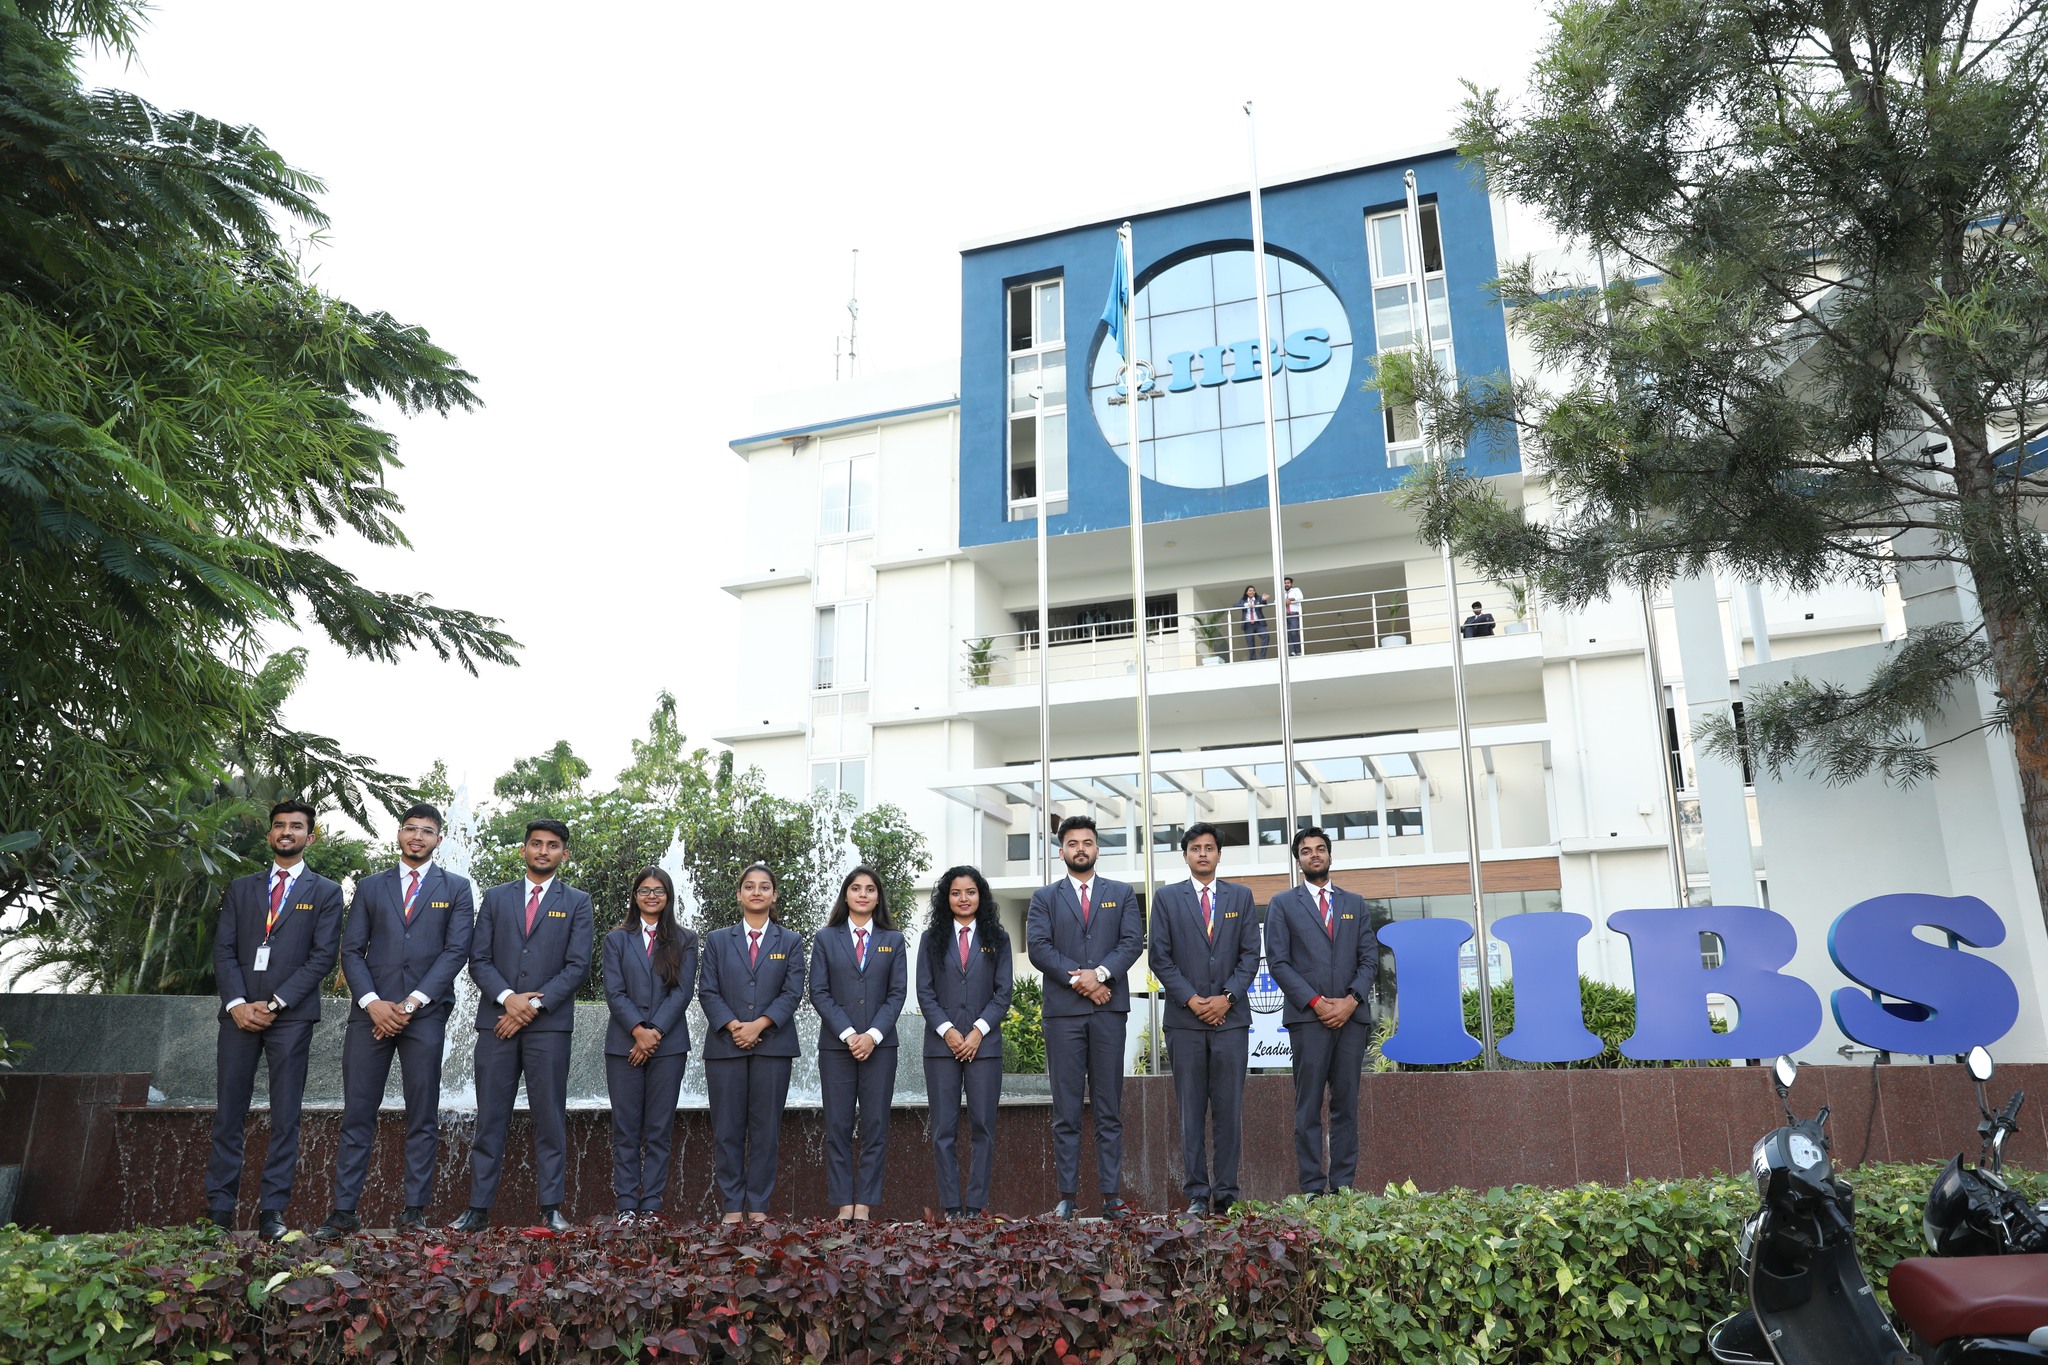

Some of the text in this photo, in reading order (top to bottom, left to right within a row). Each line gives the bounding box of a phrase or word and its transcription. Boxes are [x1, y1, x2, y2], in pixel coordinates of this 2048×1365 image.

[1167, 327, 1332, 393] IIBS
[431, 901, 450, 909] IIBS
[1101, 901, 1117, 909] IIBS
[1224, 911, 1239, 919] IIBS
[1376, 893, 2020, 1065] IIBS
